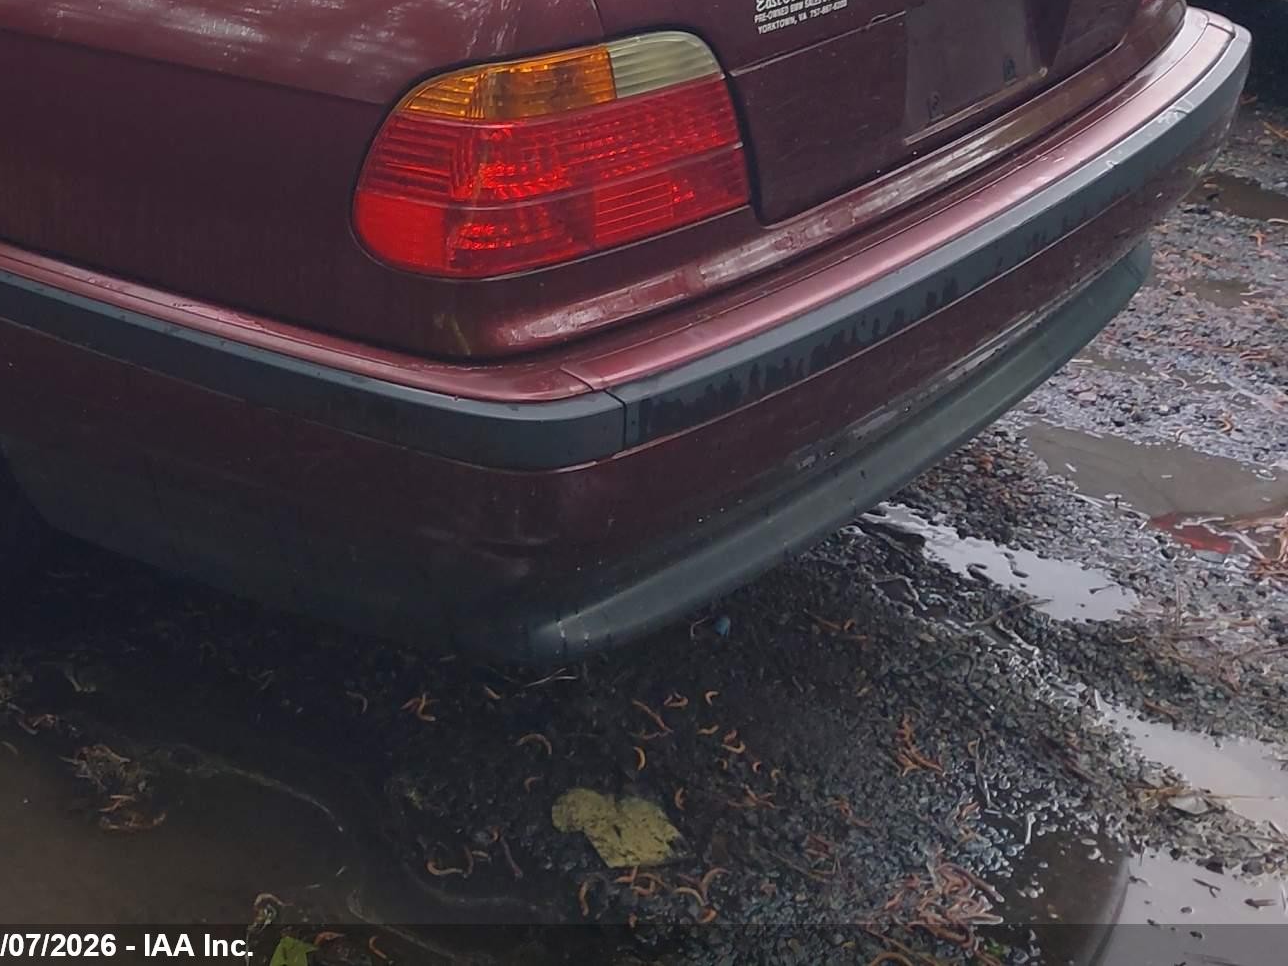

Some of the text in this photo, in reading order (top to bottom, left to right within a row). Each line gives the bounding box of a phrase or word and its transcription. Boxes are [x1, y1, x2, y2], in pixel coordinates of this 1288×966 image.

[754, 6, 789, 23] PRE-OWNED
[758, 16, 798, 34] YORKTOWN,
[798, 12, 808, 22] VA
